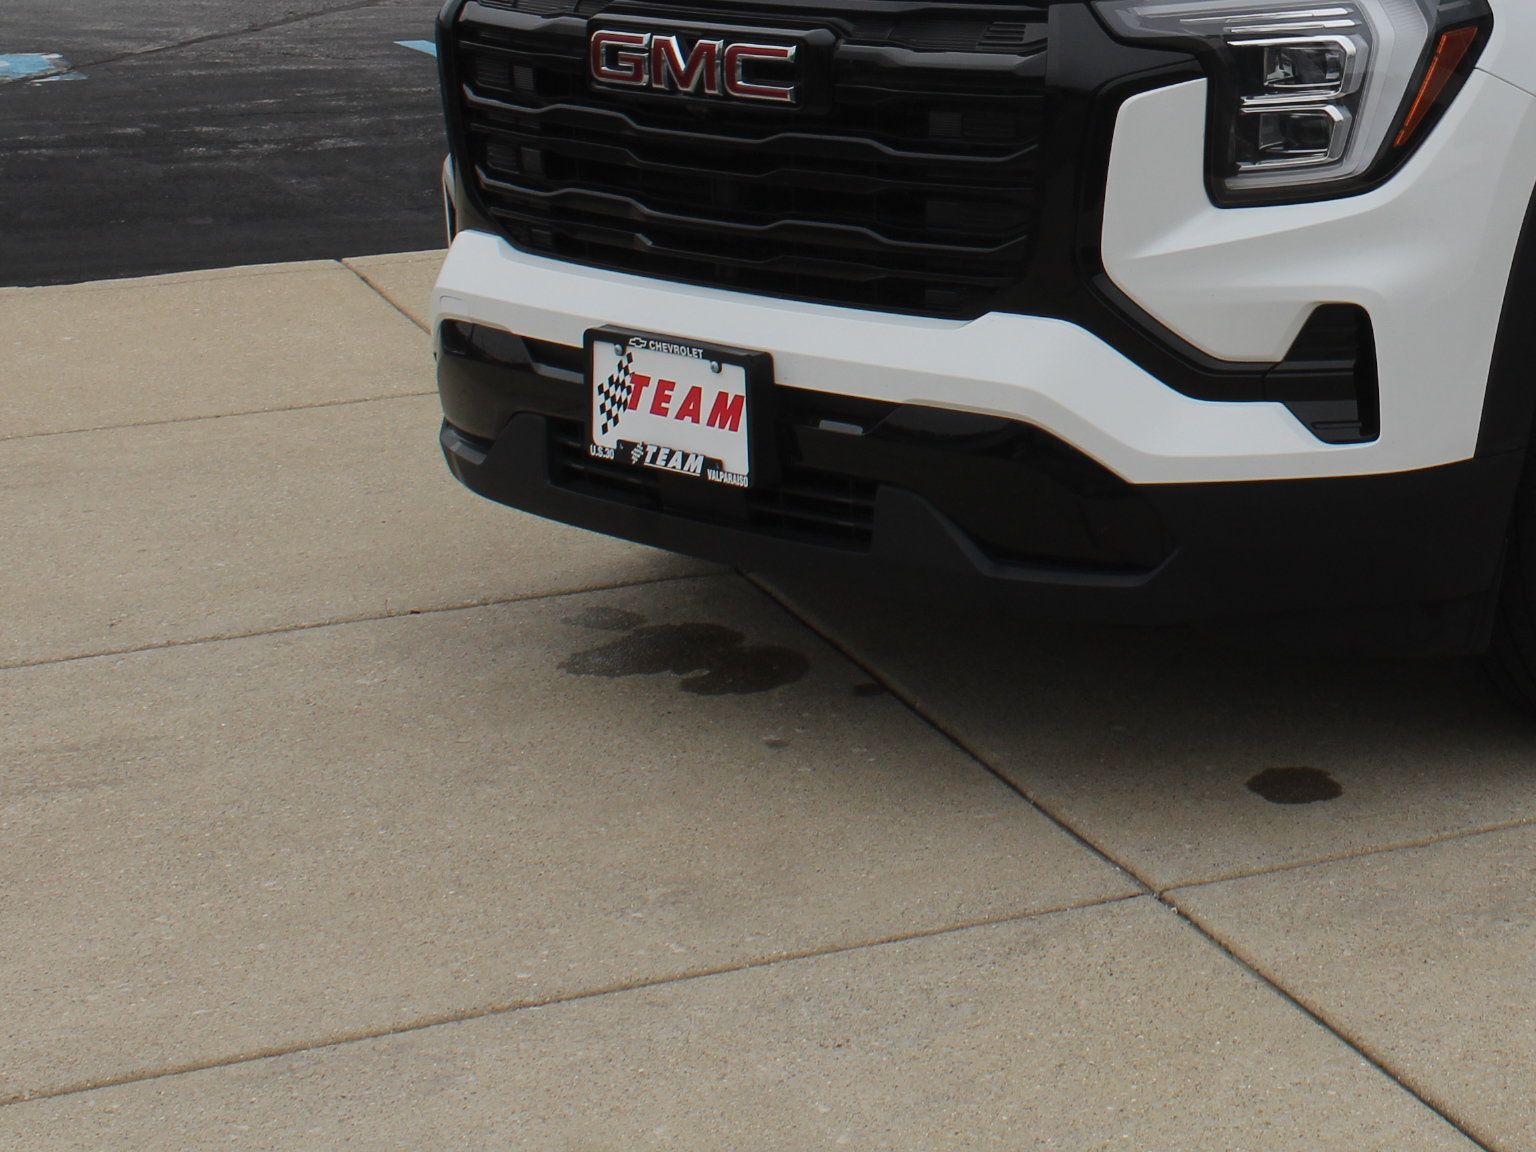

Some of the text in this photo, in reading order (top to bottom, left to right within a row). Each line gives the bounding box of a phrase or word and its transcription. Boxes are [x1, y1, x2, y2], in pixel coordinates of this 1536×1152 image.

[590, 29, 797, 104] GMC
[649, 340, 703, 358] CHEVROLET
[627, 373, 745, 432] TEAM
[644, 445, 704, 475] TEAM
[707, 470, 749, 488] VALPARAISO
